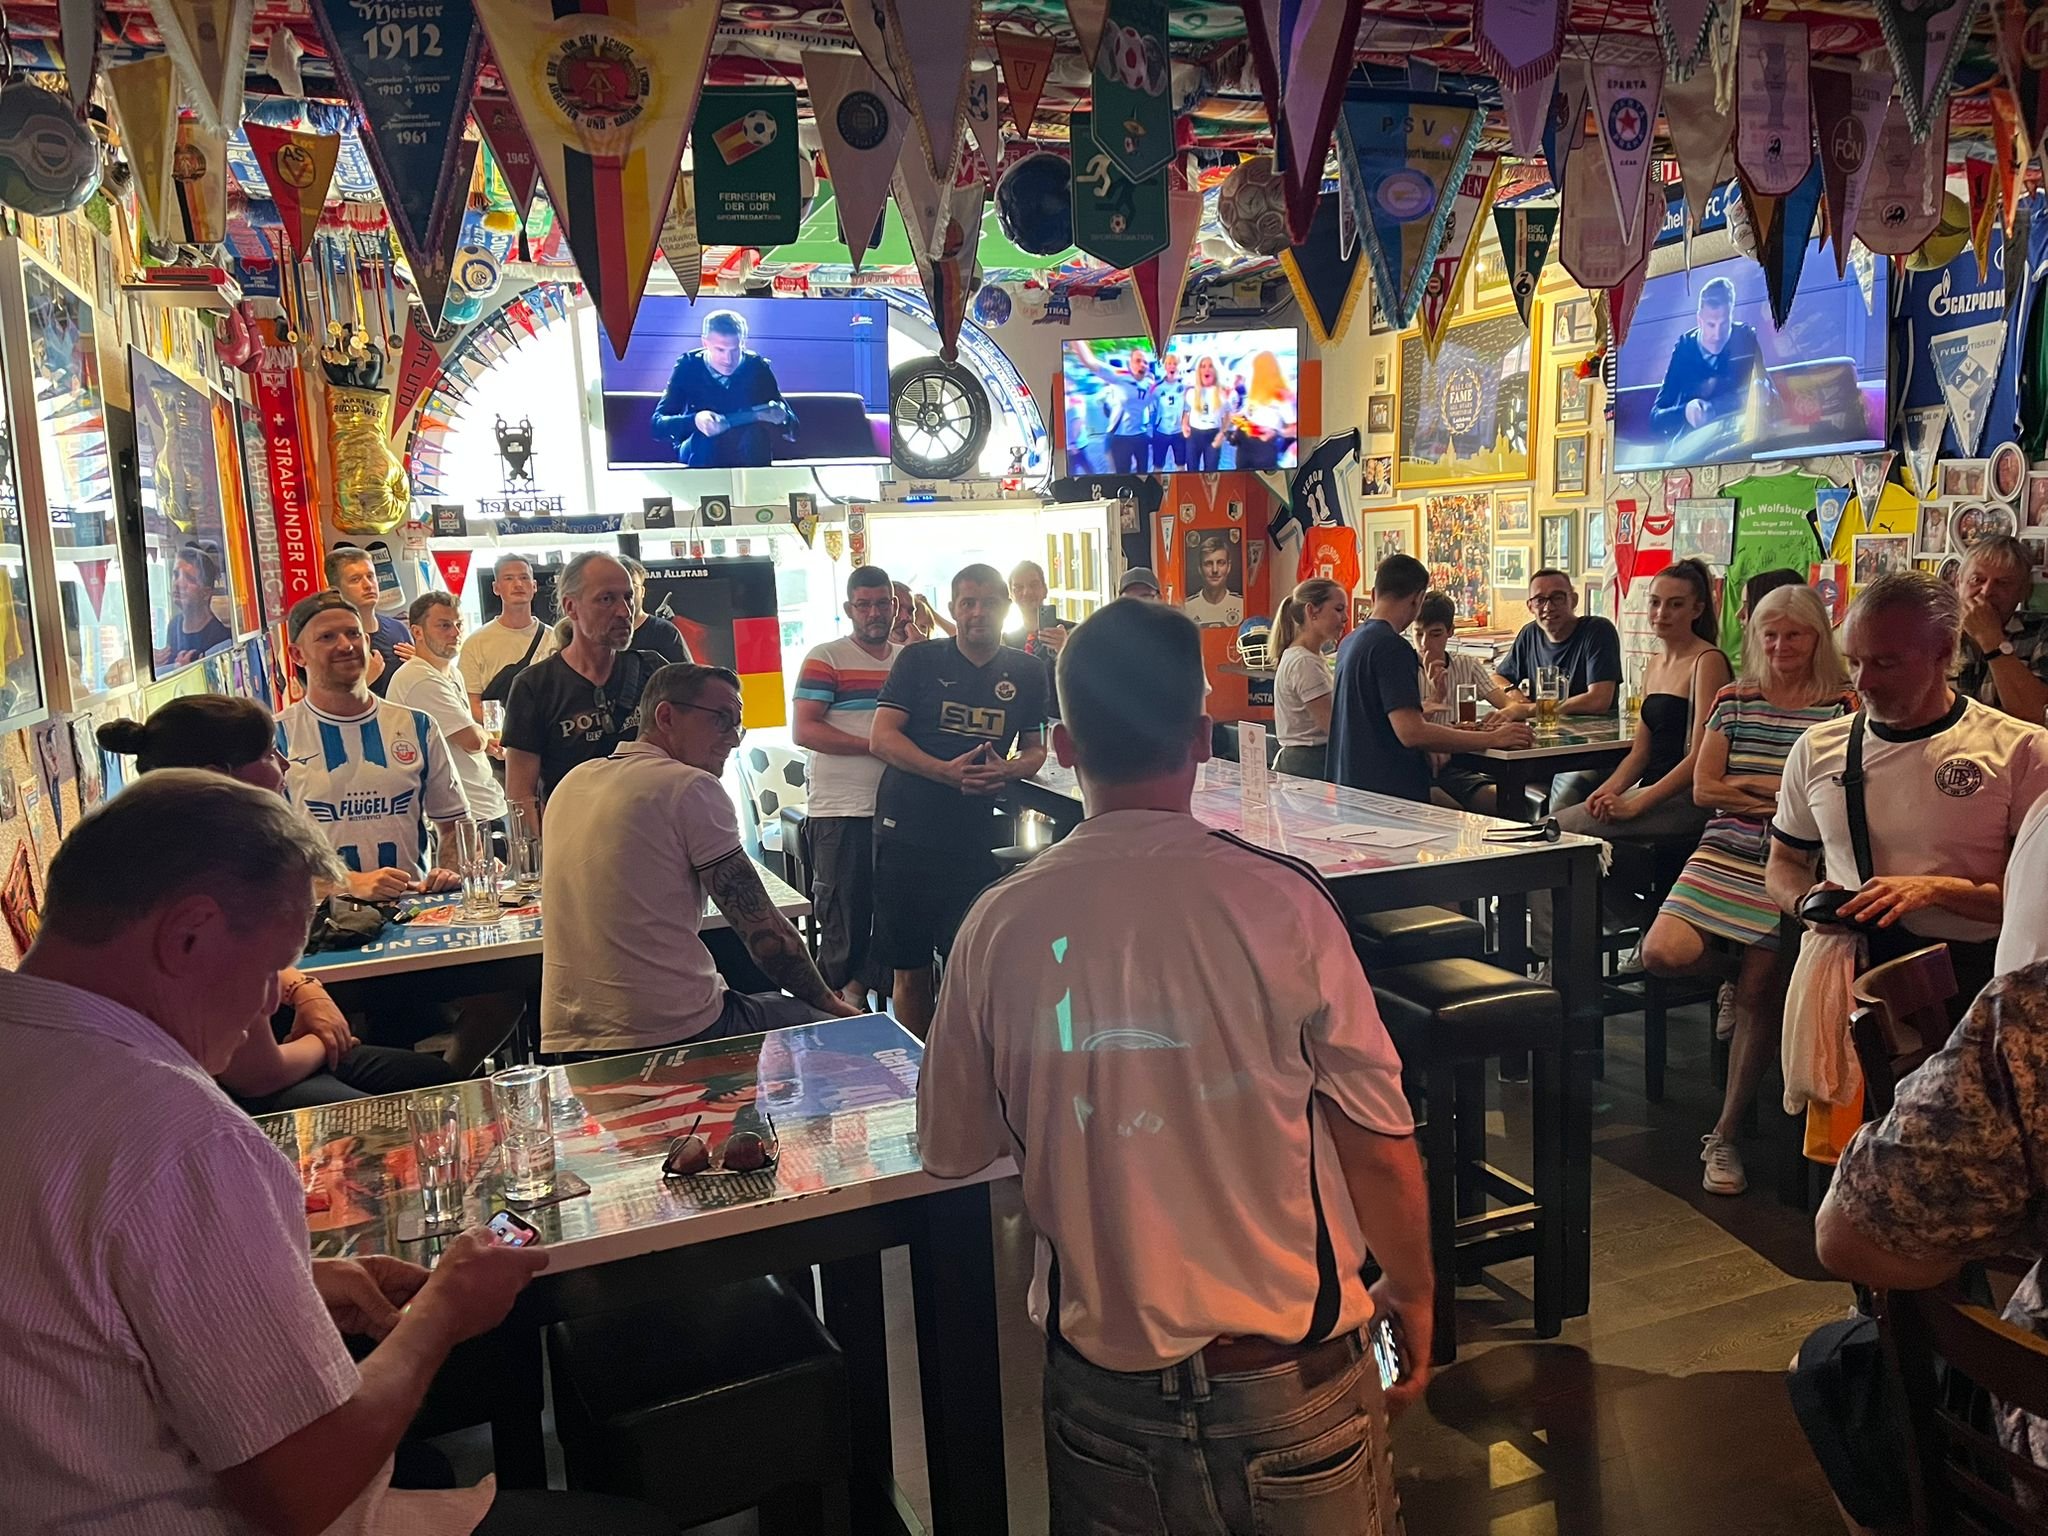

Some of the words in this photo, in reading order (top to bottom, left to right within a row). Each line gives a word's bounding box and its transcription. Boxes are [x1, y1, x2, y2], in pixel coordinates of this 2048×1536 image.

[363, 23, 443, 60] 1912
[378, 84, 403, 96] 1910
[414, 83, 441, 94] 1930
[586, 118, 606, 130] UND
[396, 130, 427, 144] 1961
[1834, 138, 1862, 161] FCN
[506, 152, 530, 165] 1945
[718, 192, 777, 202] FERNSEHEN
[724, 202, 746, 212] DER
[749, 202, 770, 212] DDR
[1705, 196, 1721, 219] FC
[1527, 224, 1545, 234] BSG
[1527, 233, 1548, 242] BUNA
[1950, 288, 2005, 315] GAZPROM
[411, 341, 433, 369] ATL
[400, 374, 422, 407] UTD
[1450, 390, 1473, 404] FAME
[274, 436, 305, 563] STRALSUNDER
[291, 567, 309, 592] FC
[439, 509, 457, 521] sky
[1740, 505, 1756, 519] VfL
[1758, 503, 1808, 520] Wolfsburg
[943, 704, 1003, 731] SLT
